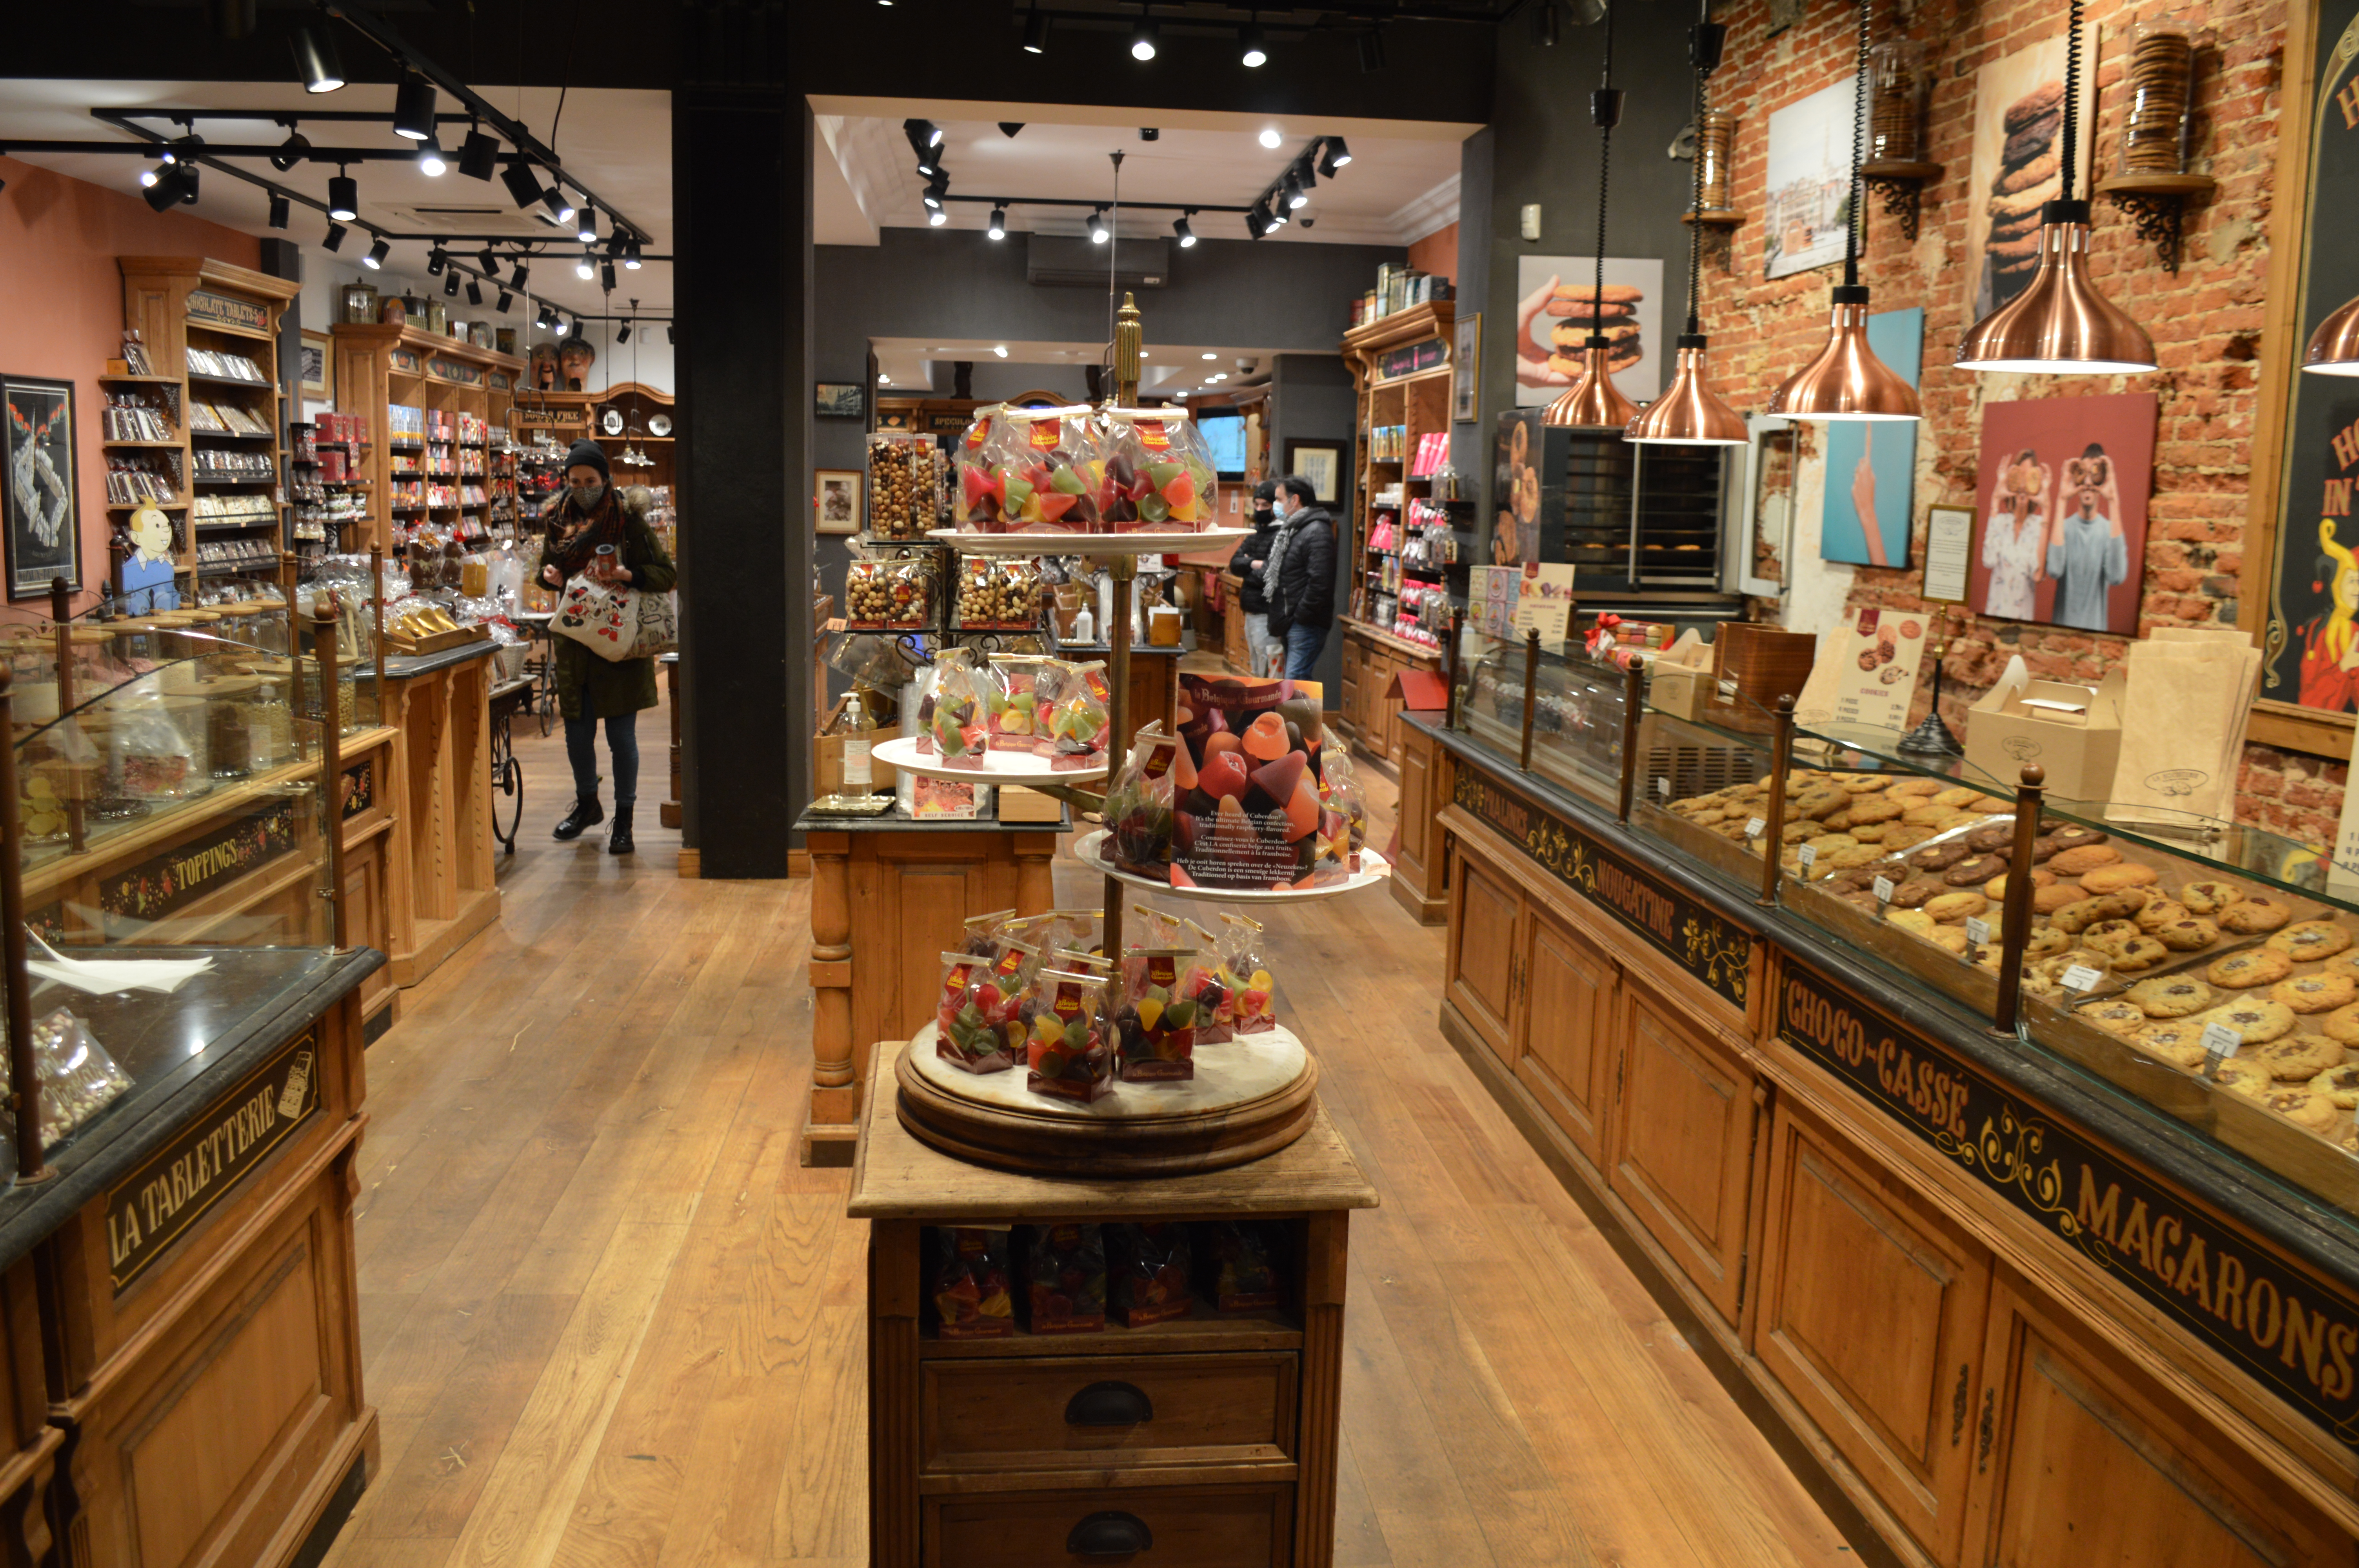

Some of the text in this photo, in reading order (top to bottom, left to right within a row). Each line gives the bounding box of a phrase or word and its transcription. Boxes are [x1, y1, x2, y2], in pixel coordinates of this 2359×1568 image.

[557, 410, 578, 421] FREE
[935, 417, 976, 426] SPECULOO
[2321, 478, 2354, 516] IN
[1195, 688, 1281, 706] la Belgique Gourmande
[1483, 786, 1529, 840] PRALINES
[177, 838, 239, 890] TOPPINGS
[1596, 858, 1675, 944] NOUGATINE
[1787, 978, 1969, 1140] CHOCO-CASSÉ
[109, 1084, 275, 1268] LA TABLETTERIE
[2076, 1163, 2357, 1402] MACARONS
